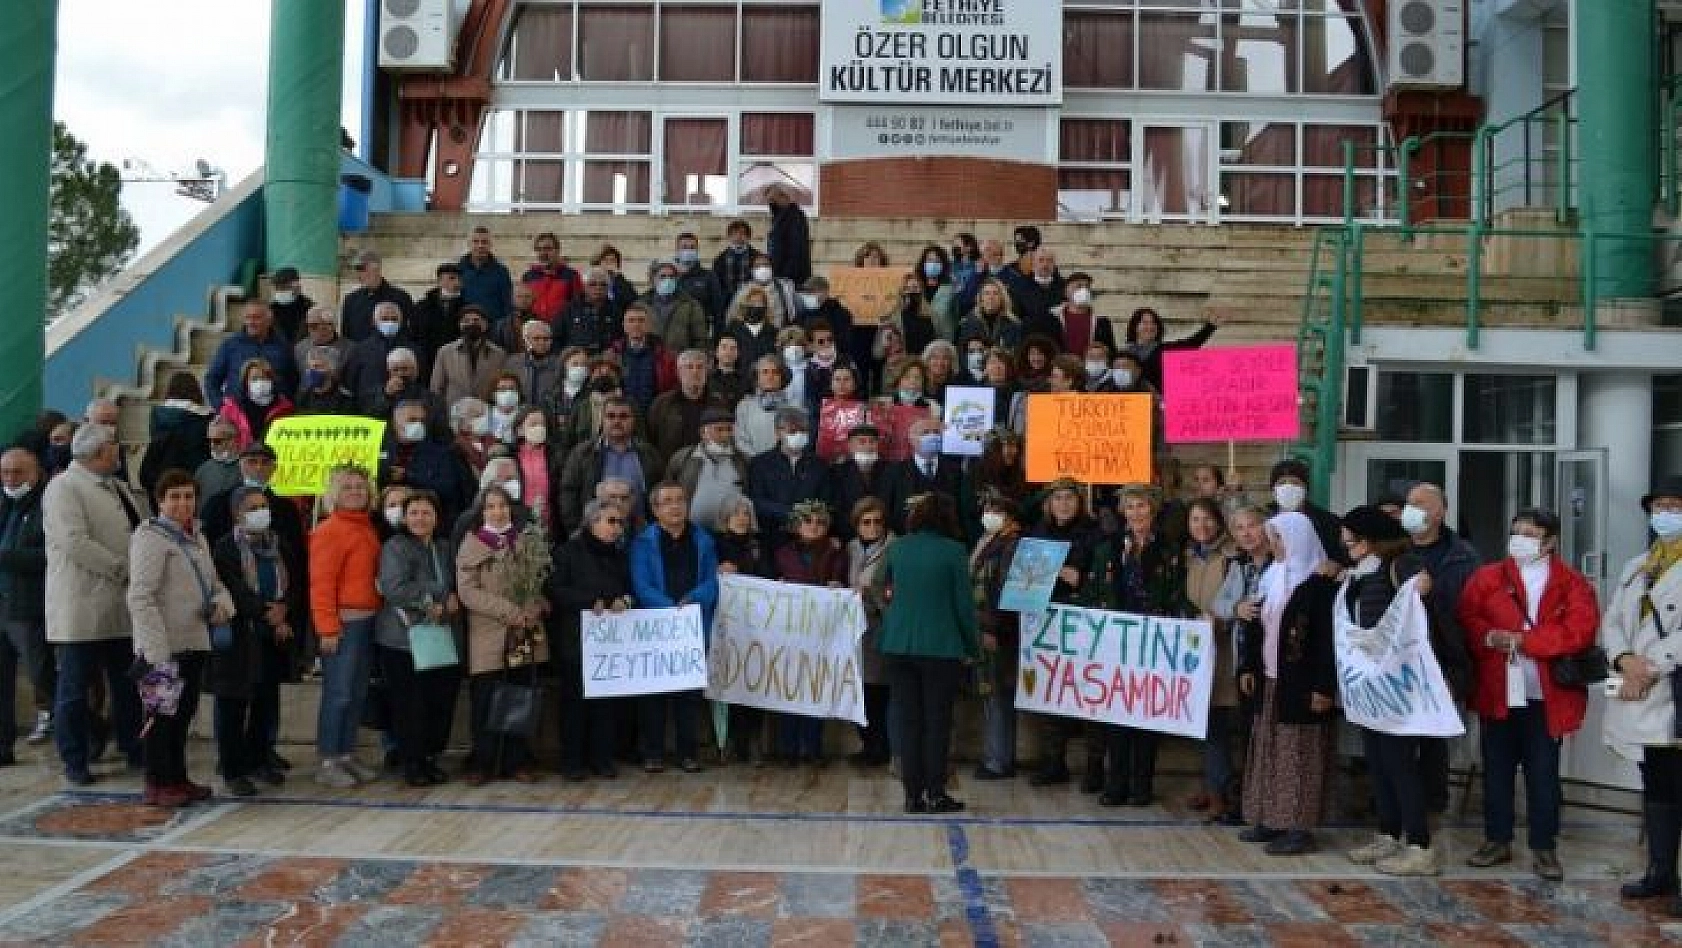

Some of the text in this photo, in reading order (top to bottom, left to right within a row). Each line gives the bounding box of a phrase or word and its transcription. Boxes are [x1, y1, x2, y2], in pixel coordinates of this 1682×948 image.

[855, 25, 1029, 60] ÖZER OLGUN
[831, 60, 1052, 93] KÜLTÜR MERKEZİ
[631, 614, 699, 641] MADEN
[1032, 607, 1181, 673] ZEYTİN
[590, 646, 704, 681] ZEYTİNDİR
[717, 638, 858, 708] DOKUNMA
[1036, 654, 1193, 722] YAŞAMDIR
